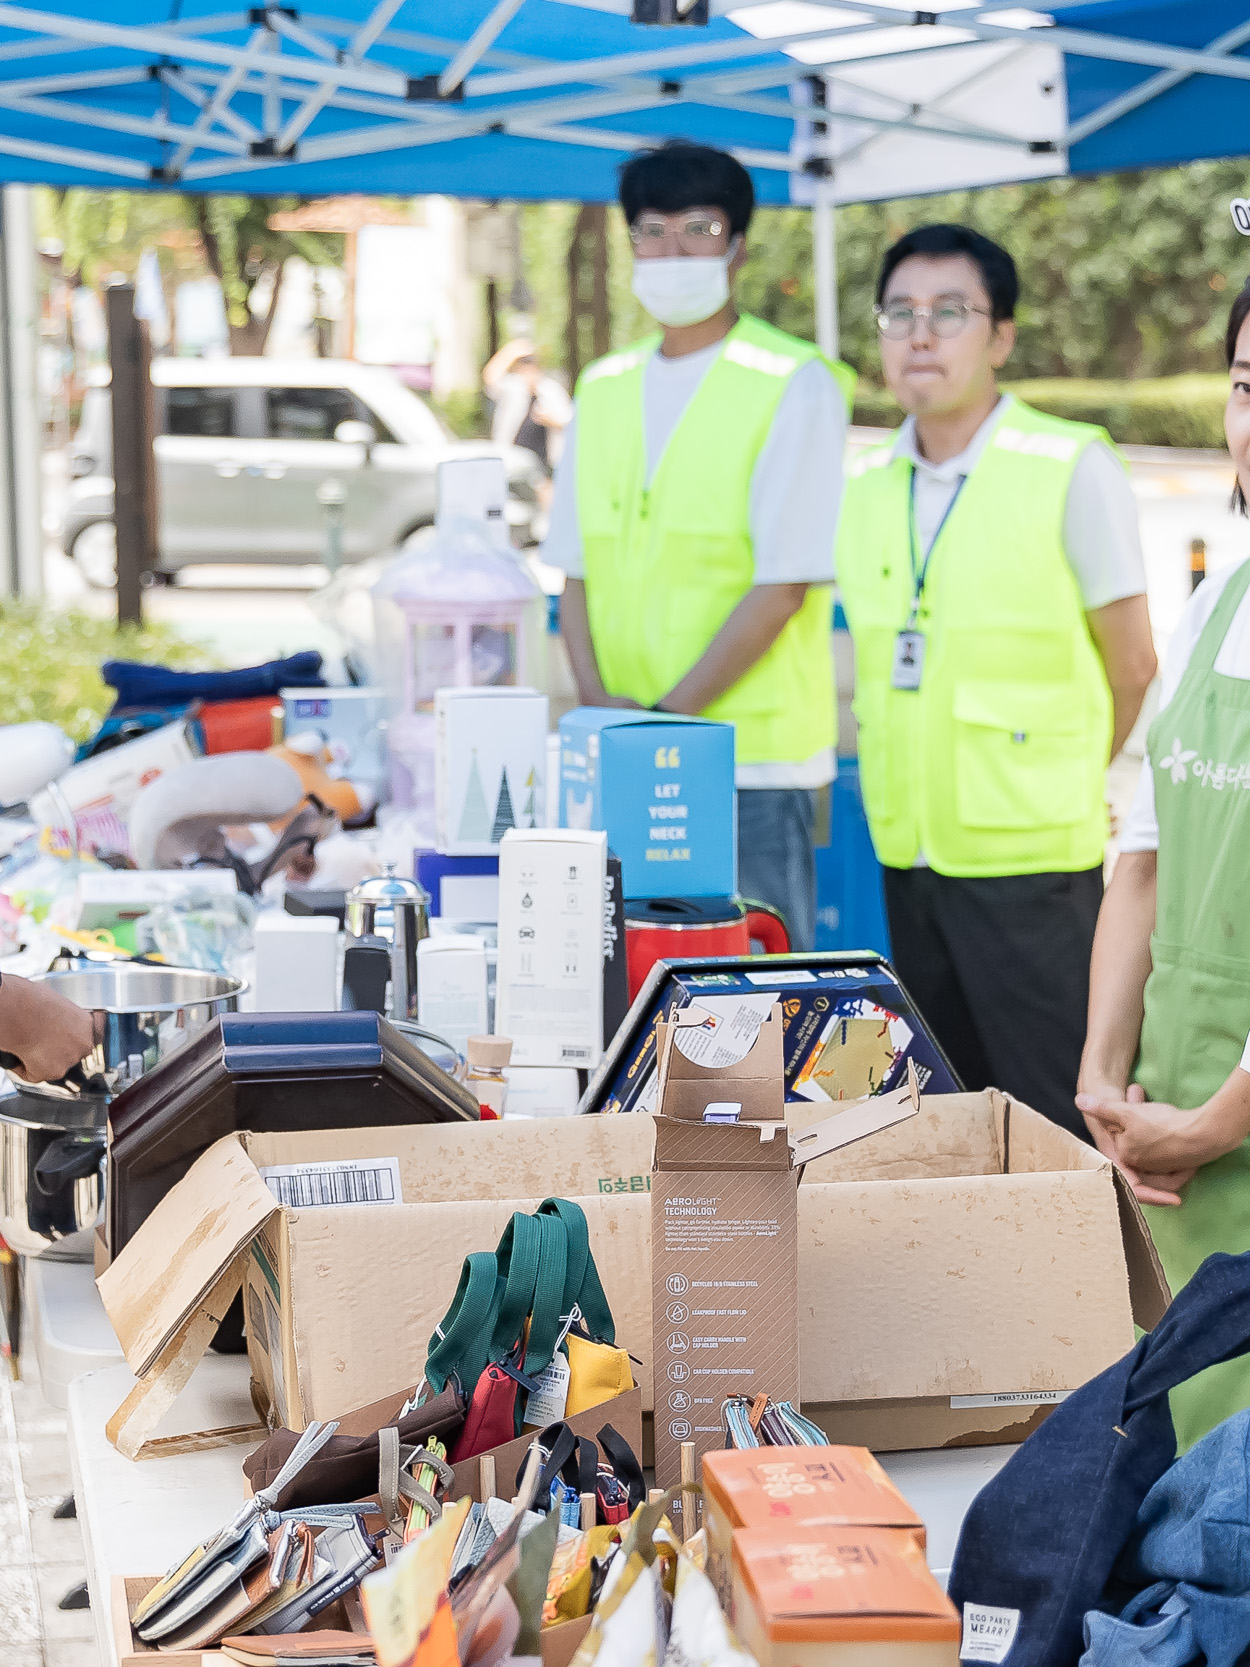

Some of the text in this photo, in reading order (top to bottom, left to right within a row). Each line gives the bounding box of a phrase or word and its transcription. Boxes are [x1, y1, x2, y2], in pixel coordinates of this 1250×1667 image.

[654, 783, 681, 799] LET
[648, 804, 689, 820] YOUR
[649, 826, 687, 841] NECK
[644, 847, 691, 862] RELAX
[664, 1207, 718, 1216] TECHNOLOGY
[993, 1392, 1057, 1402] 18803733164334
[969, 1613, 1012, 1627] ECO PARTY
[970, 1623, 1010, 1638] MEARRY
